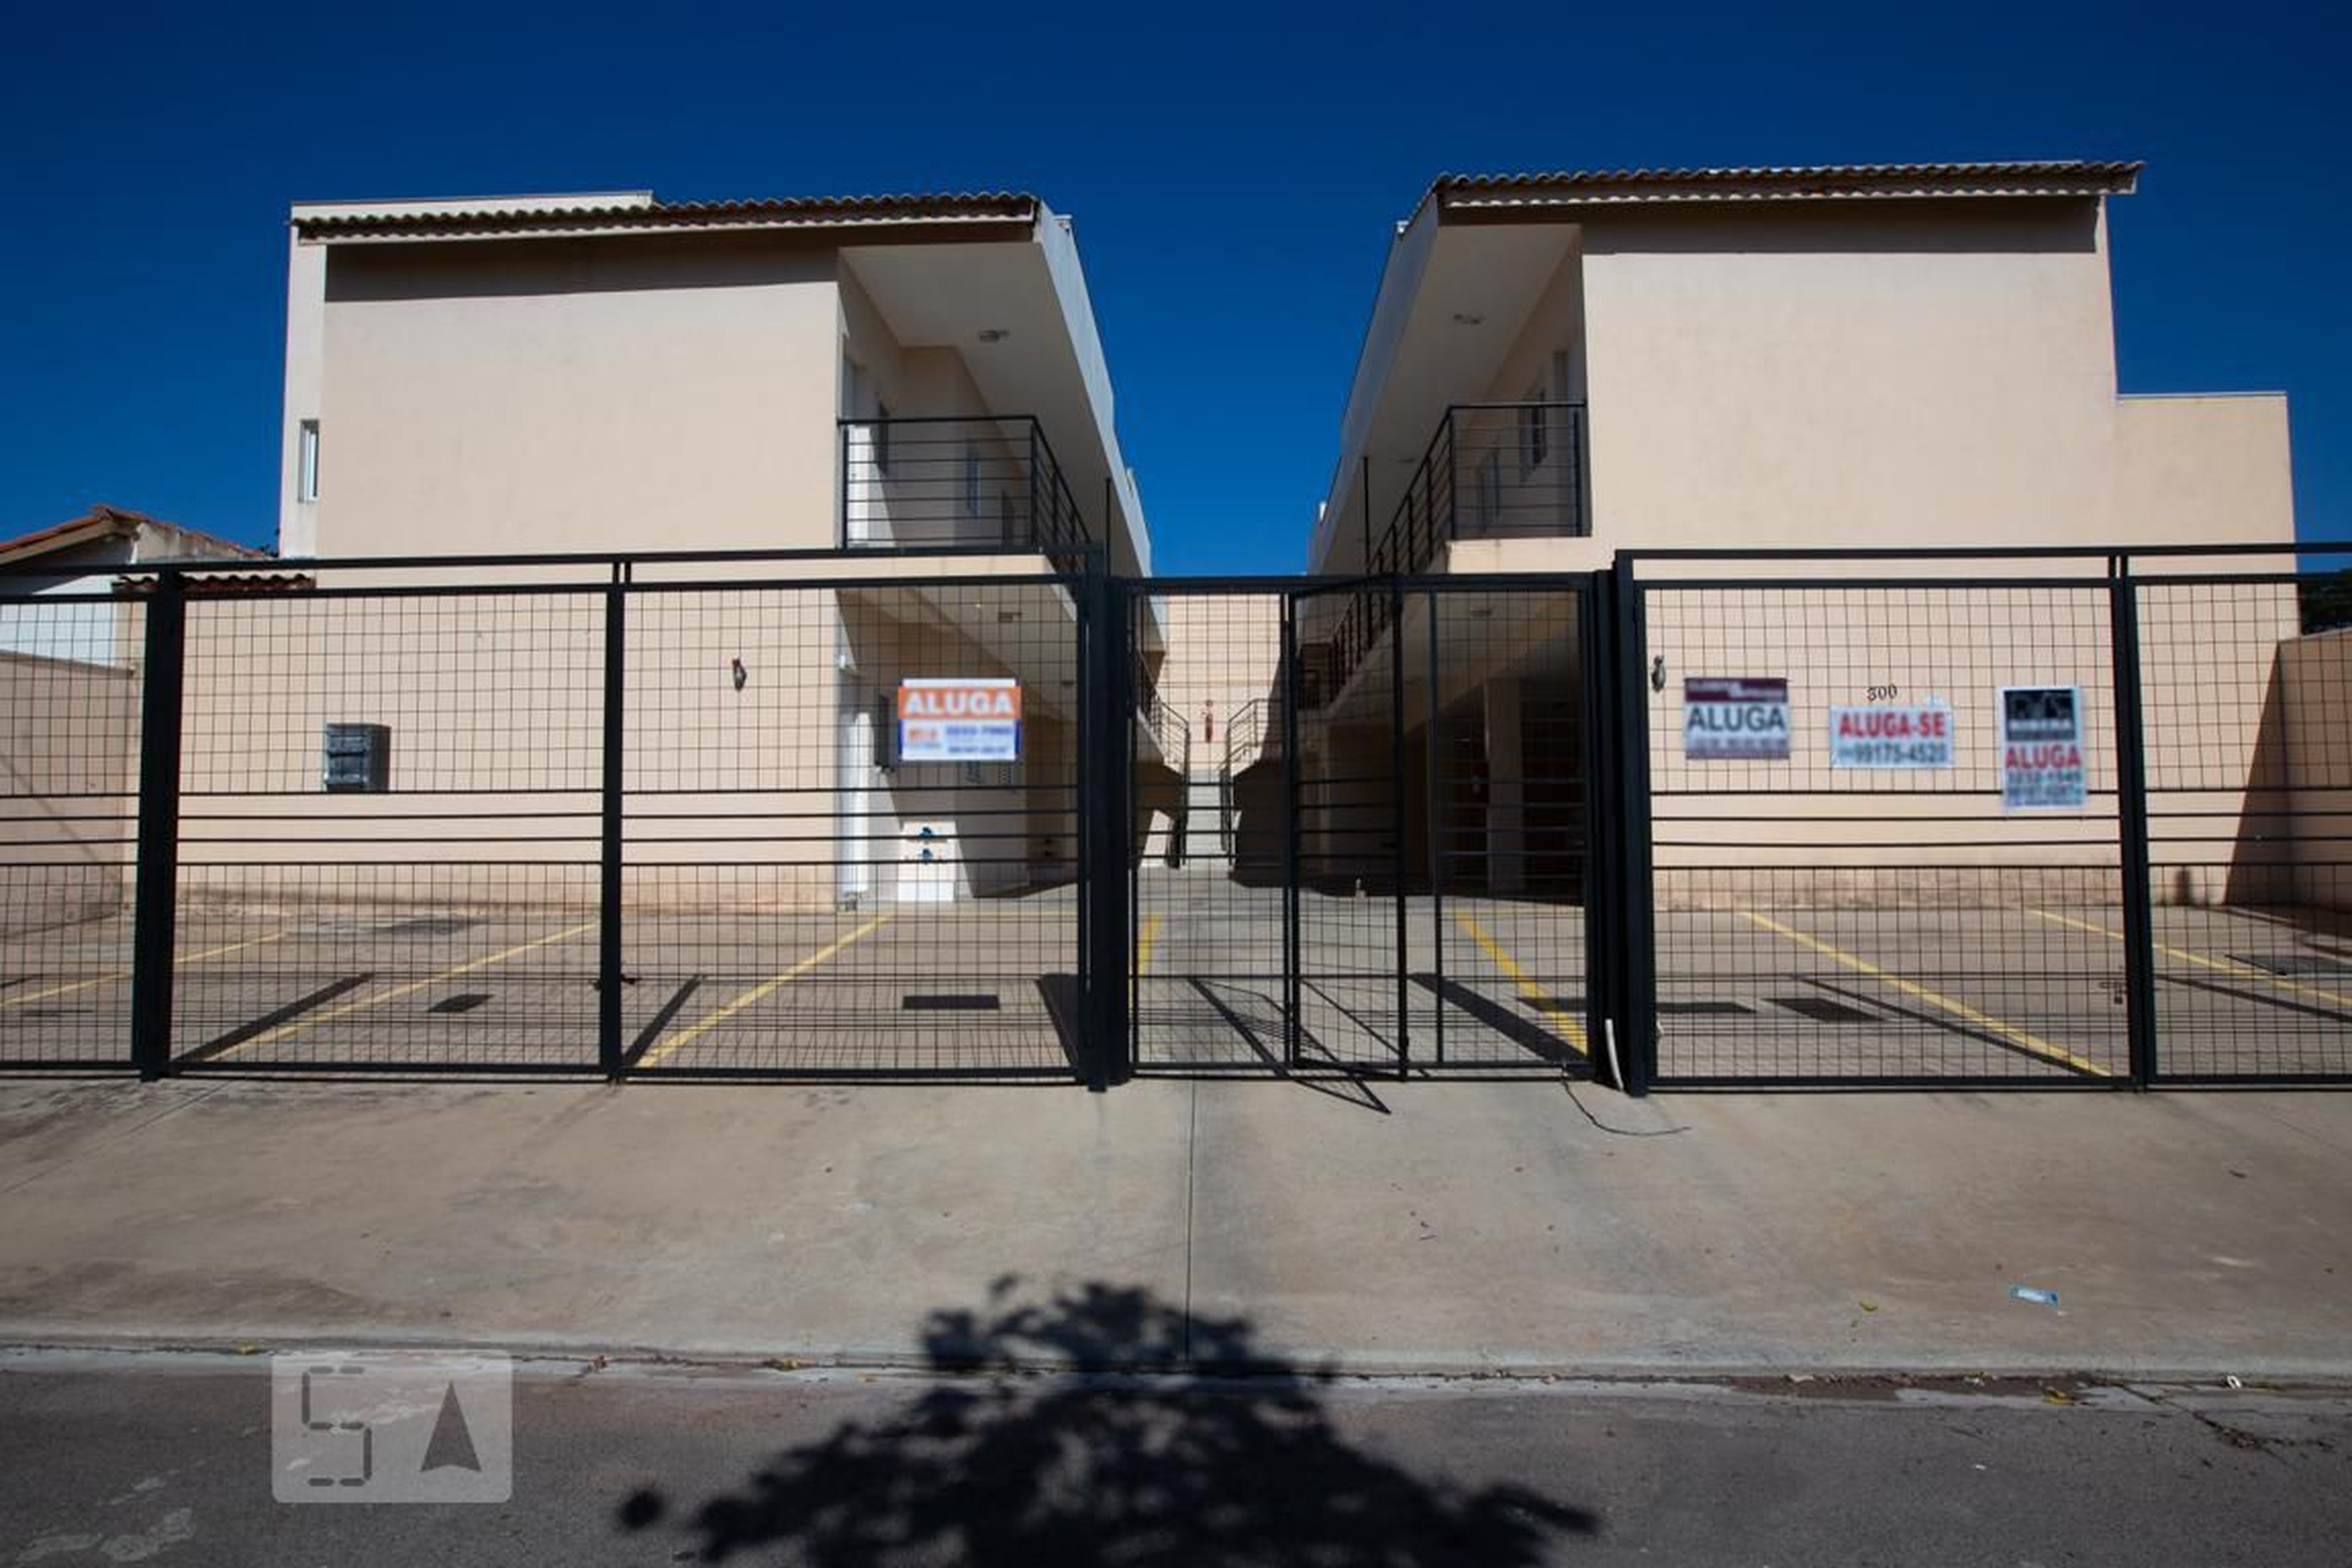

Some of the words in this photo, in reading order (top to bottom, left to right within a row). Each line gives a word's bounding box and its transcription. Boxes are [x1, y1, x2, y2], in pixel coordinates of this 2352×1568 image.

[907, 691, 1014, 714] ALUGA
[1687, 705, 1785, 732] ALUGA
[1839, 712, 1945, 738] ALUGA-SE
[2005, 745, 2081, 768] ALUGA
